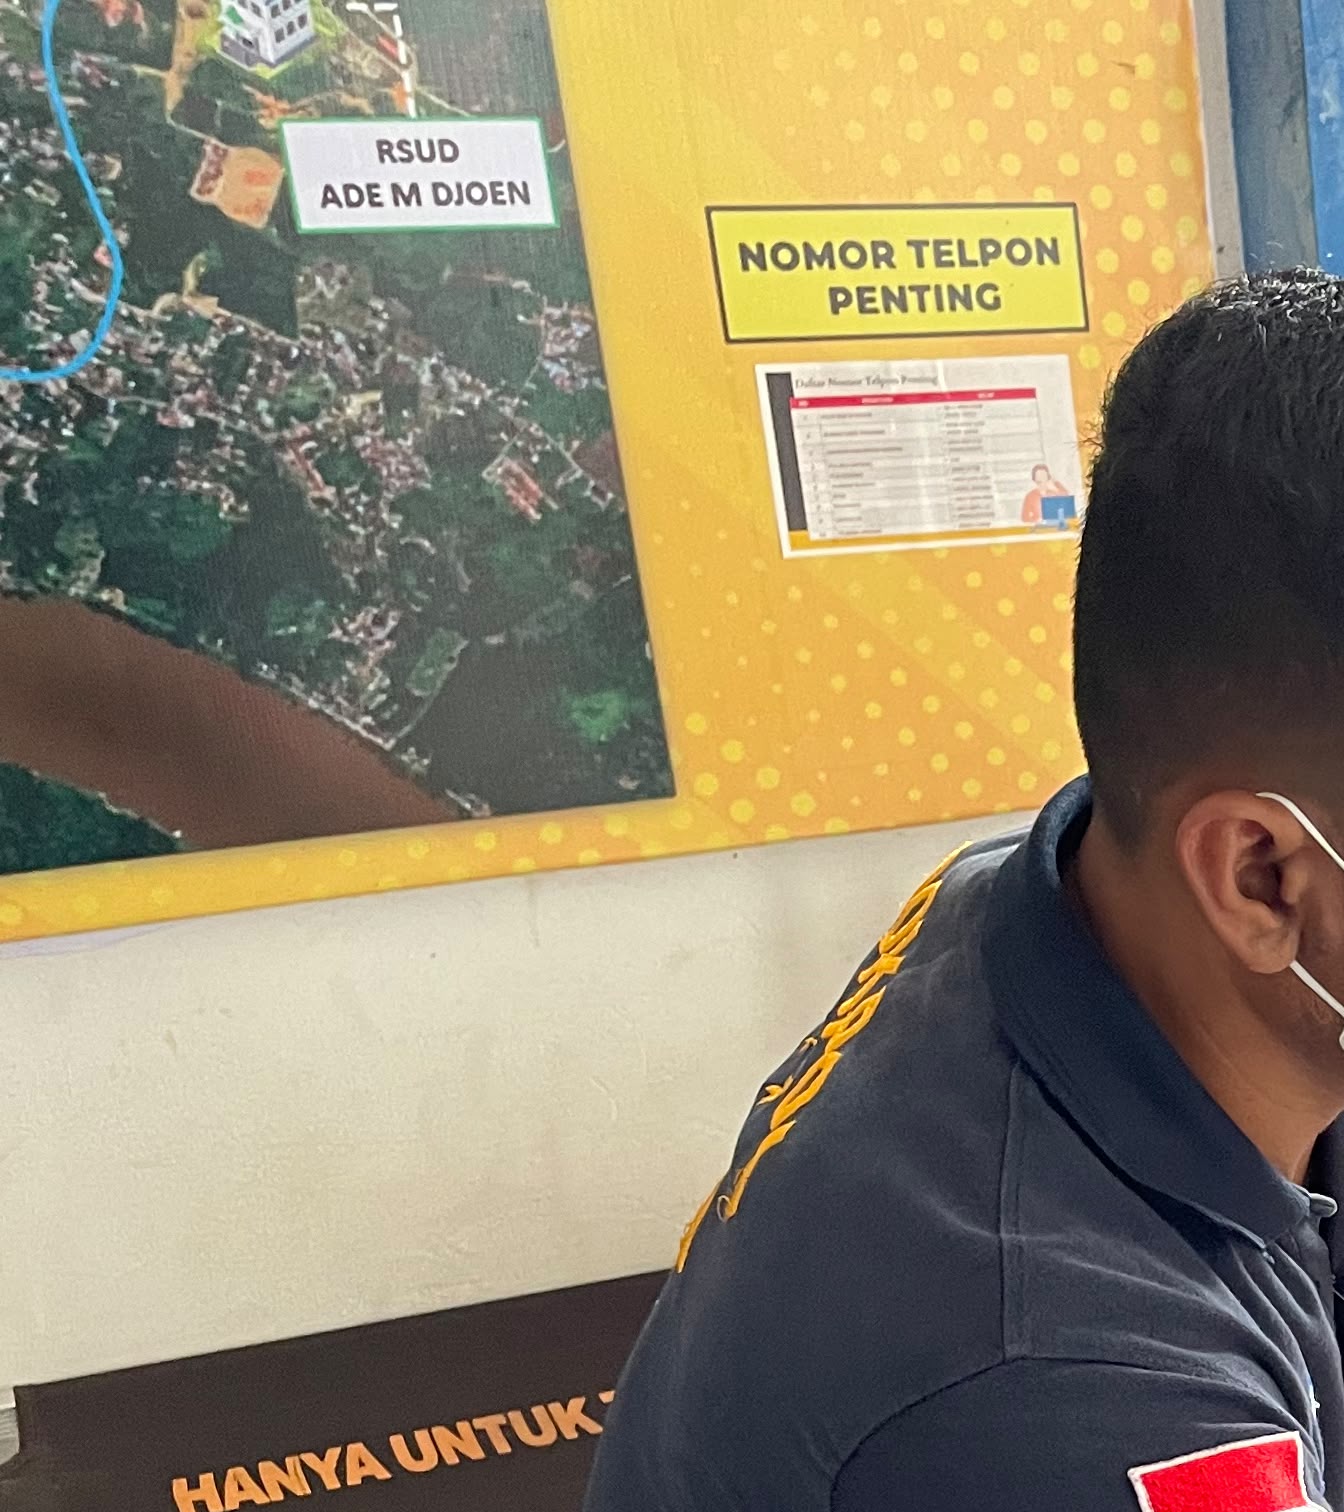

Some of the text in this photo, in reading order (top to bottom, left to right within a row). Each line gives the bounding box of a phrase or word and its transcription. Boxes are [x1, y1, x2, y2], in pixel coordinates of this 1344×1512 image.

[376, 138, 460, 164] RSUD
[320, 180, 532, 208] ADE M DJOEN
[738, 237, 1062, 272] NOMOR TELPON
[828, 282, 1002, 315] PENTING
[389, 1396, 604, 1473] UNTUK
